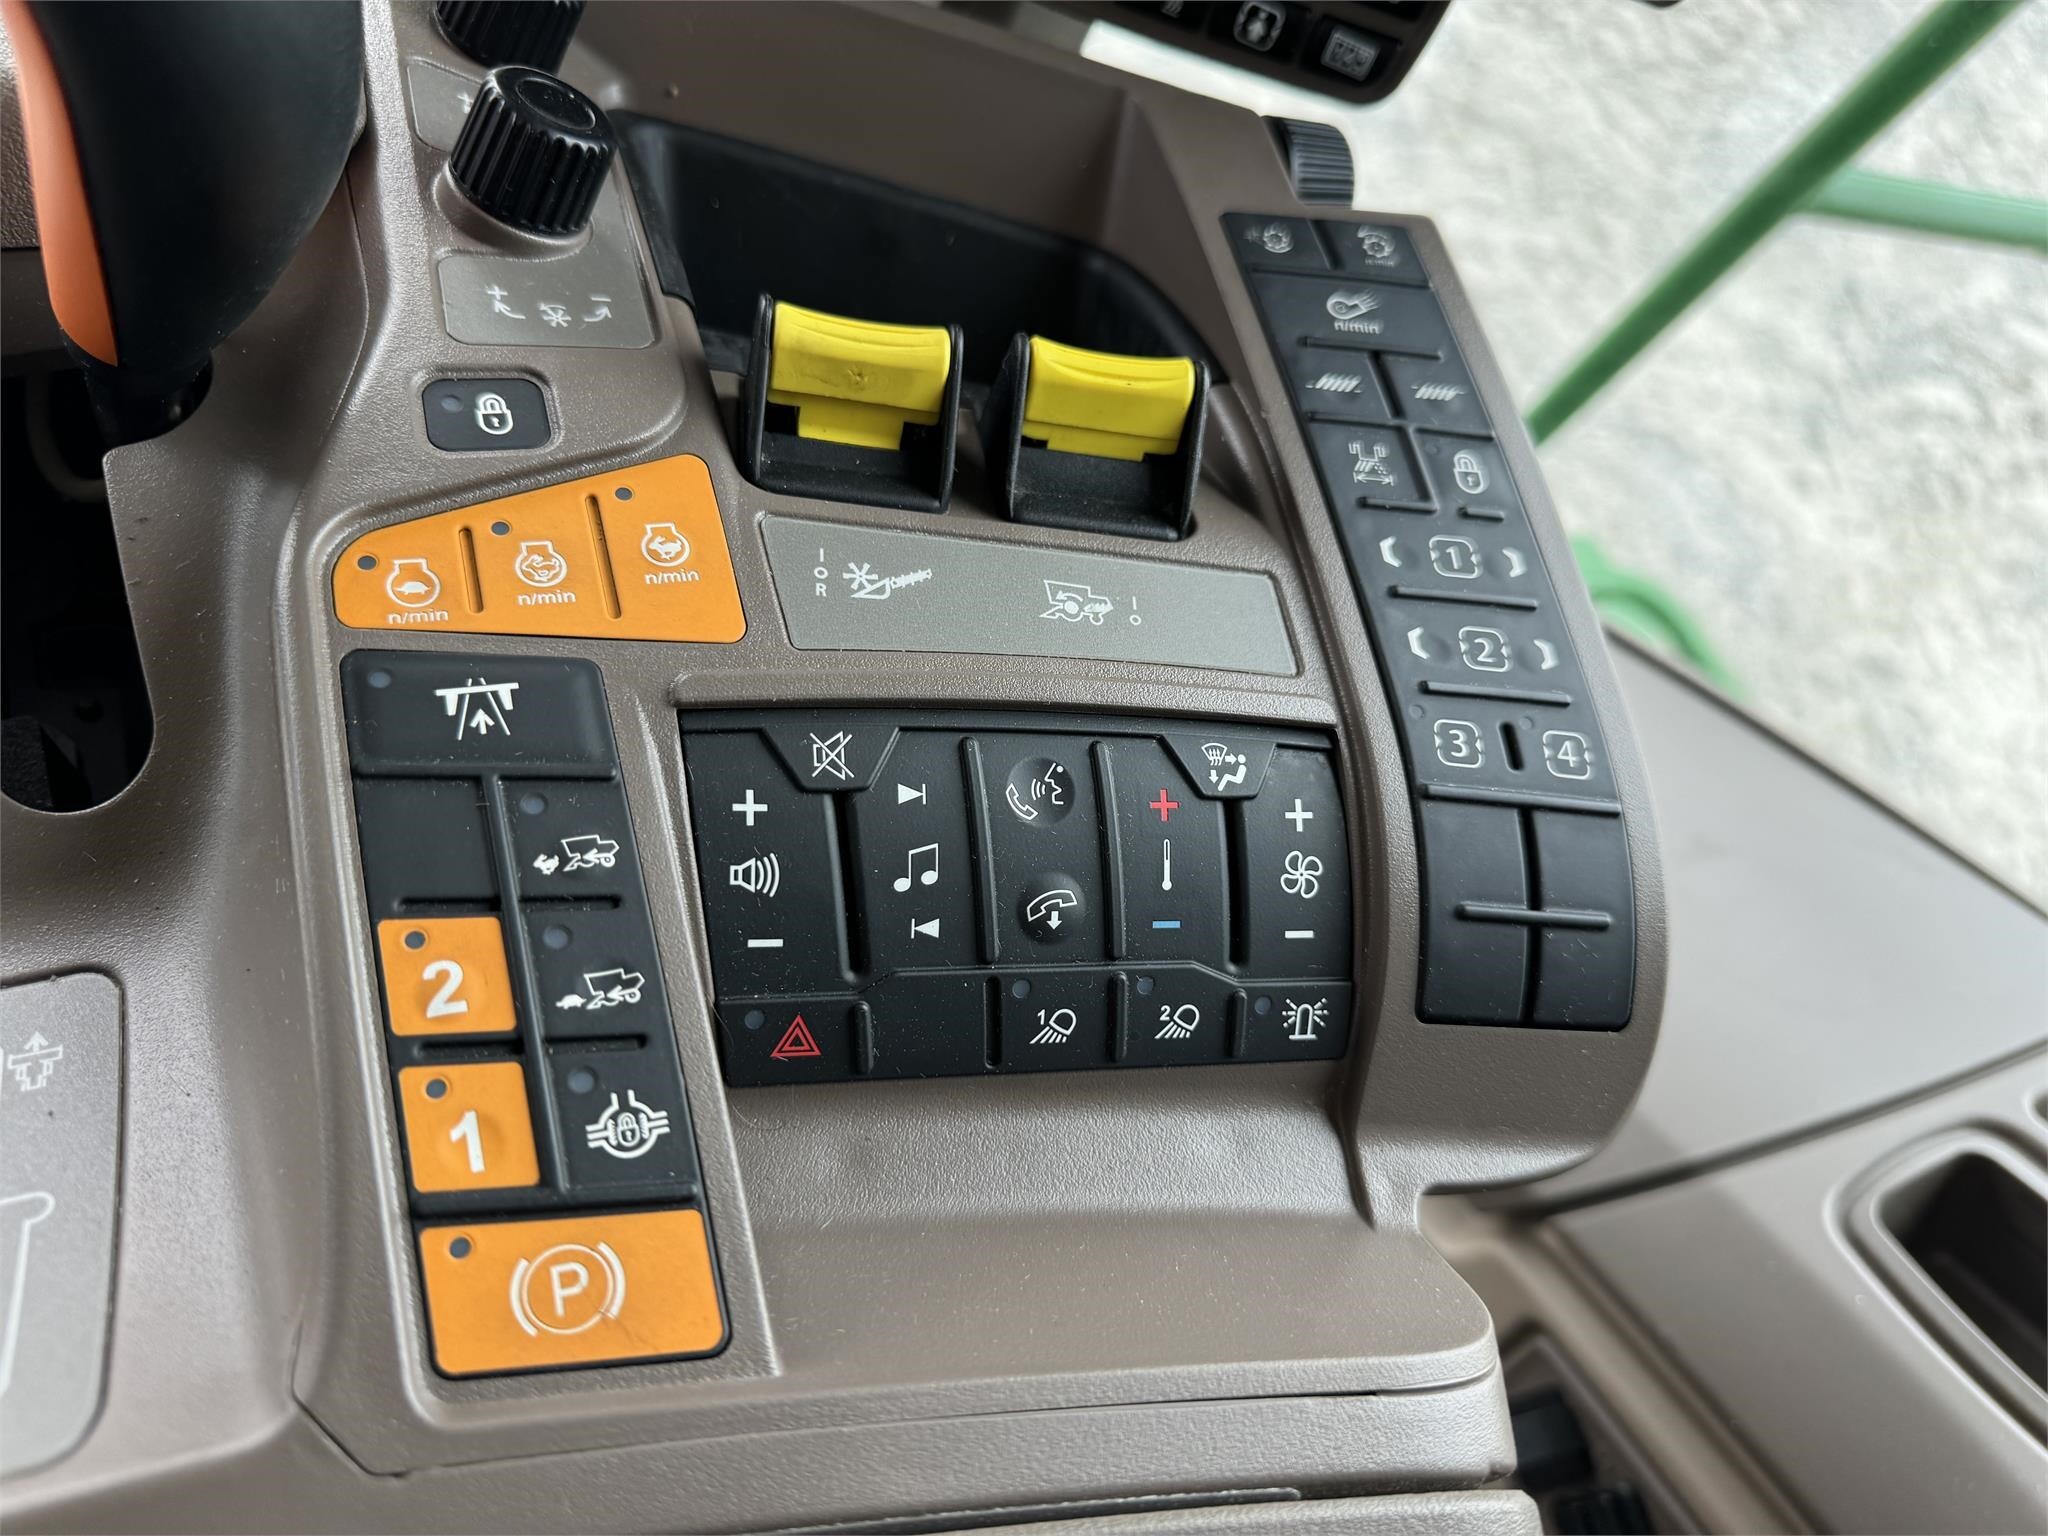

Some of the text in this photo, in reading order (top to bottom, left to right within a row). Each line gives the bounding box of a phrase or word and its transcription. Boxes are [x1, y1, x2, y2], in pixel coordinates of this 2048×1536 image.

[1334, 319, 1381, 335] n/min
[1446, 546, 1461, 570] 1
[643, 568, 700, 585] n/min
[517, 590, 577, 606] n/min
[815, 582, 827, 597] R
[387, 608, 449, 625] n/min
[1474, 638, 1497, 662] 2
[1449, 729, 1468, 758] 3
[1557, 740, 1577, 768] 4
[422, 959, 469, 1020] 2
[1037, 1009, 1046, 1025] 1
[1159, 1005, 1170, 1021] 2
[449, 1110, 486, 1174] 1
[549, 1261, 589, 1318] P
